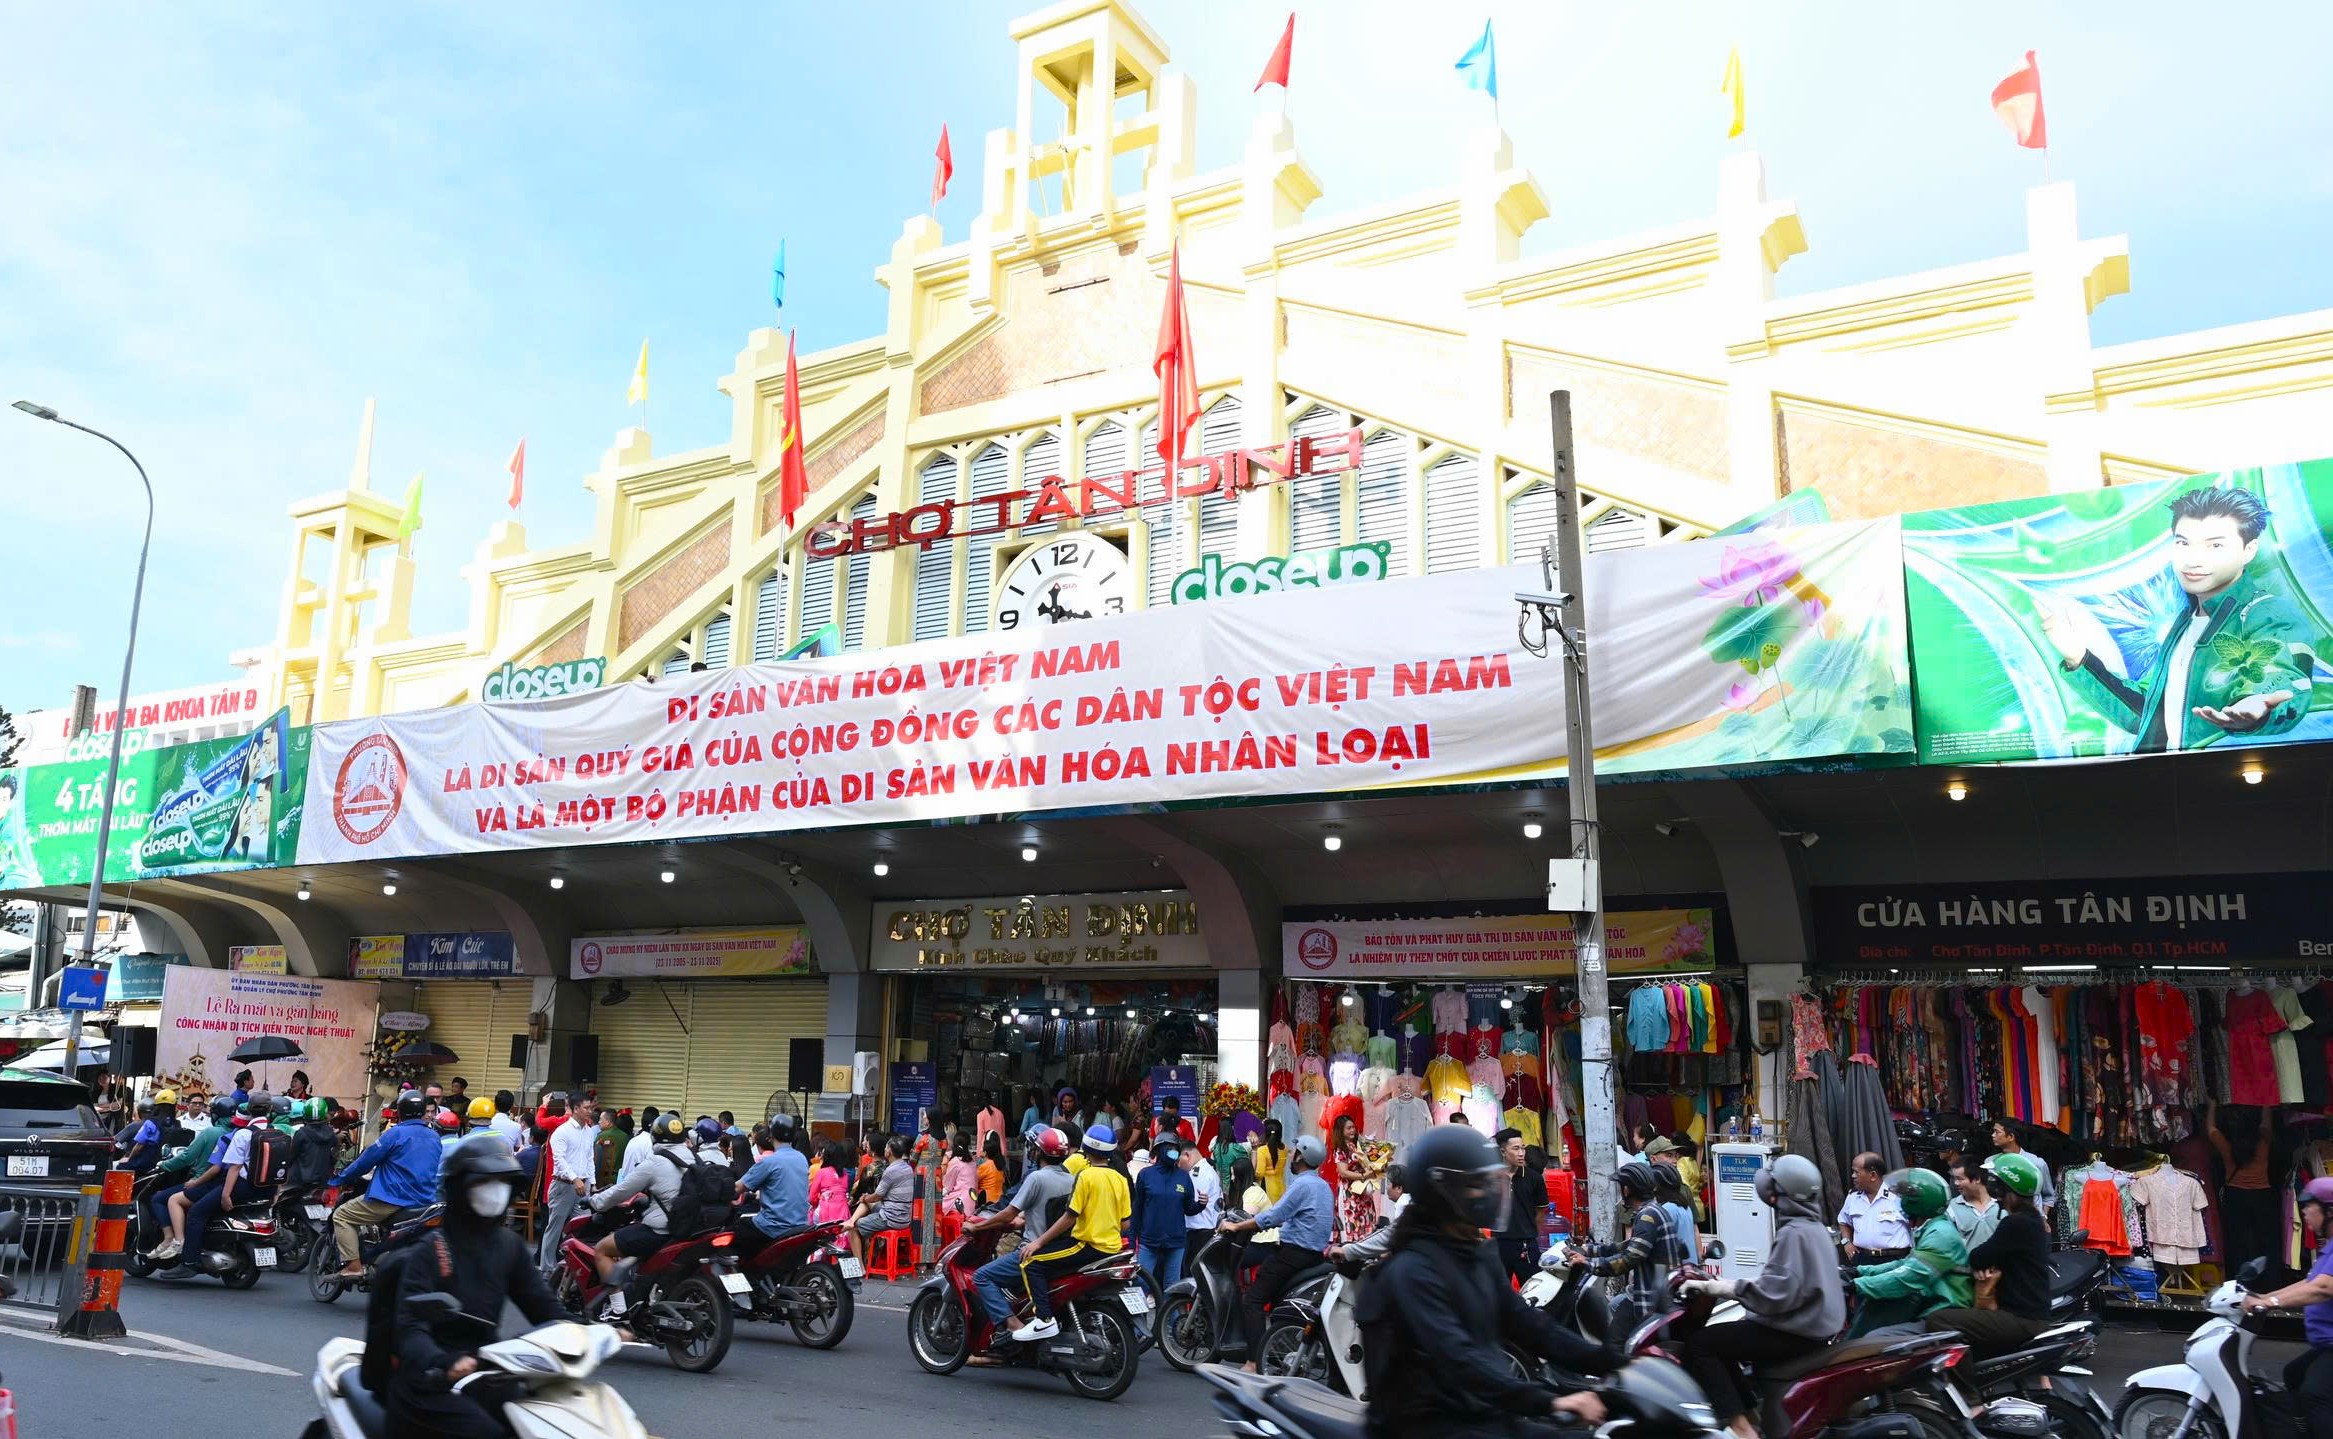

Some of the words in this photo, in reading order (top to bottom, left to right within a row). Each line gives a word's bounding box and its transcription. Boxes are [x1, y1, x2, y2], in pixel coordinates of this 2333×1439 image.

[804, 499, 955, 559] CHỢ
[980, 474, 1138, 530] TÂN
[1163, 427, 1365, 499] ĐỊNH
[1051, 543, 1078, 566] 12
[1000, 610, 1019, 630] 9
[485, 661, 600, 701] closeup
[668, 694, 698, 724] DI
[708, 683, 766, 717] SẢN
[778, 674, 841, 710] VĂN
[851, 661, 927, 699] HÓA
[939, 651, 1018, 691] VIỆT
[1031, 640, 1121, 679] NAM
[140, 706, 160, 727] ĐA
[164, 697, 205, 723] KHOA
[210, 688, 240, 716] TÂN
[443, 763, 473, 793] LÀ
[480, 763, 506, 790] DI
[515, 754, 566, 786] SẢN
[575, 744, 634, 779] QUÝ
[641, 738, 696, 774] GIÁ
[705, 731, 763, 766] CỦA
[771, 722, 861, 764] CỘNG
[870, 705, 982, 748] ĐỒNG
[992, 696, 1062, 736] CÁC
[1075, 685, 1164, 727] DÂN
[1179, 675, 1261, 723] TỘC
[1276, 662, 1377, 712] VIỆT
[1393, 652, 1512, 697] NAM
[475, 801, 508, 834] VÀ
[516, 799, 547, 829] LÀ
[554, 793, 616, 832] MỘT
[626, 791, 667, 827] BỘ
[677, 781, 762, 821] PHẬN
[772, 771, 833, 808] CỦA
[841, 775, 874, 801] DI
[886, 758, 957, 800] SẢN
[968, 749, 1048, 792] VĂN
[1061, 741, 1153, 783] HÓA
[1165, 730, 1298, 777] NHÂN
[1316, 723, 1430, 771] LOẠI
[55, 777, 74, 813] 4
[156, 793, 205, 828] closeup
[71, 818, 95, 835] MÁT
[142, 830, 193, 857] closeup
[887, 904, 973, 948] CHỢ
[983, 898, 1070, 939] TÂN
[1086, 901, 1197, 944] ĐỊNH
[1857, 896, 1927, 927] CỬA
[1938, 894, 2043, 926] HÀNG
[2055, 891, 2133, 924] TÂN
[2146, 893, 2247, 929] ĐỊNH
[430, 936, 454, 956] Kim
[462, 936, 484, 954] Cúc
[1365, 932, 1382, 946] BẢO
[1405, 933, 1418, 945] VÀ
[1420, 932, 1443, 944] PHÁT
[1446, 933, 1464, 944] HUY
[1466, 932, 1482, 944] GIÁ
[1484, 932, 1500, 944] TRỊ
[1502, 931, 1512, 942] DI
[1514, 928, 1535, 942] SẢN
[1537, 928, 1558, 942] VĂN
[1607, 926, 1626, 940] TỘC
[918, 949, 965, 965] Kính
[972, 948, 1026, 965] Chào
[1034, 945, 1078, 966] Quý
[1085, 944, 1158, 963] Khách
[1349, 952, 1360, 964] LÀ
[1362, 950, 1393, 964] NHIỆM
[1394, 952, 1407, 966] VỤ
[1408, 952, 1434, 964] THEN
[1436, 950, 1458, 963] CHỐT
[1462, 948, 1480, 962] CỦA
[1482, 948, 1510, 962] CHIẾN
[1513, 949, 1537, 963] LƯỢC
[1540, 947, 1566, 961] PHÁT
[1624, 945, 1646, 958] HÓA
[1966, 945, 1992, 956] Tân
[2162, 942, 2228, 958] Tp.HCM
[206, 996, 222, 1013] Lễ
[225, 998, 240, 1014] Ra
[270, 1001, 284, 1017] và
[176, 1017, 200, 1030] CÔNG
[202, 1020, 228, 1032] NHẬN
[230, 1022, 238, 1032] DI
[242, 1021, 259, 1034] TÍCH
[262, 1021, 282, 1034] KIẾN
[284, 1023, 305, 1036] TRÚC
[307, 1026, 328, 1039] NGHỆ
[330, 1027, 355, 1040] THUẬT
